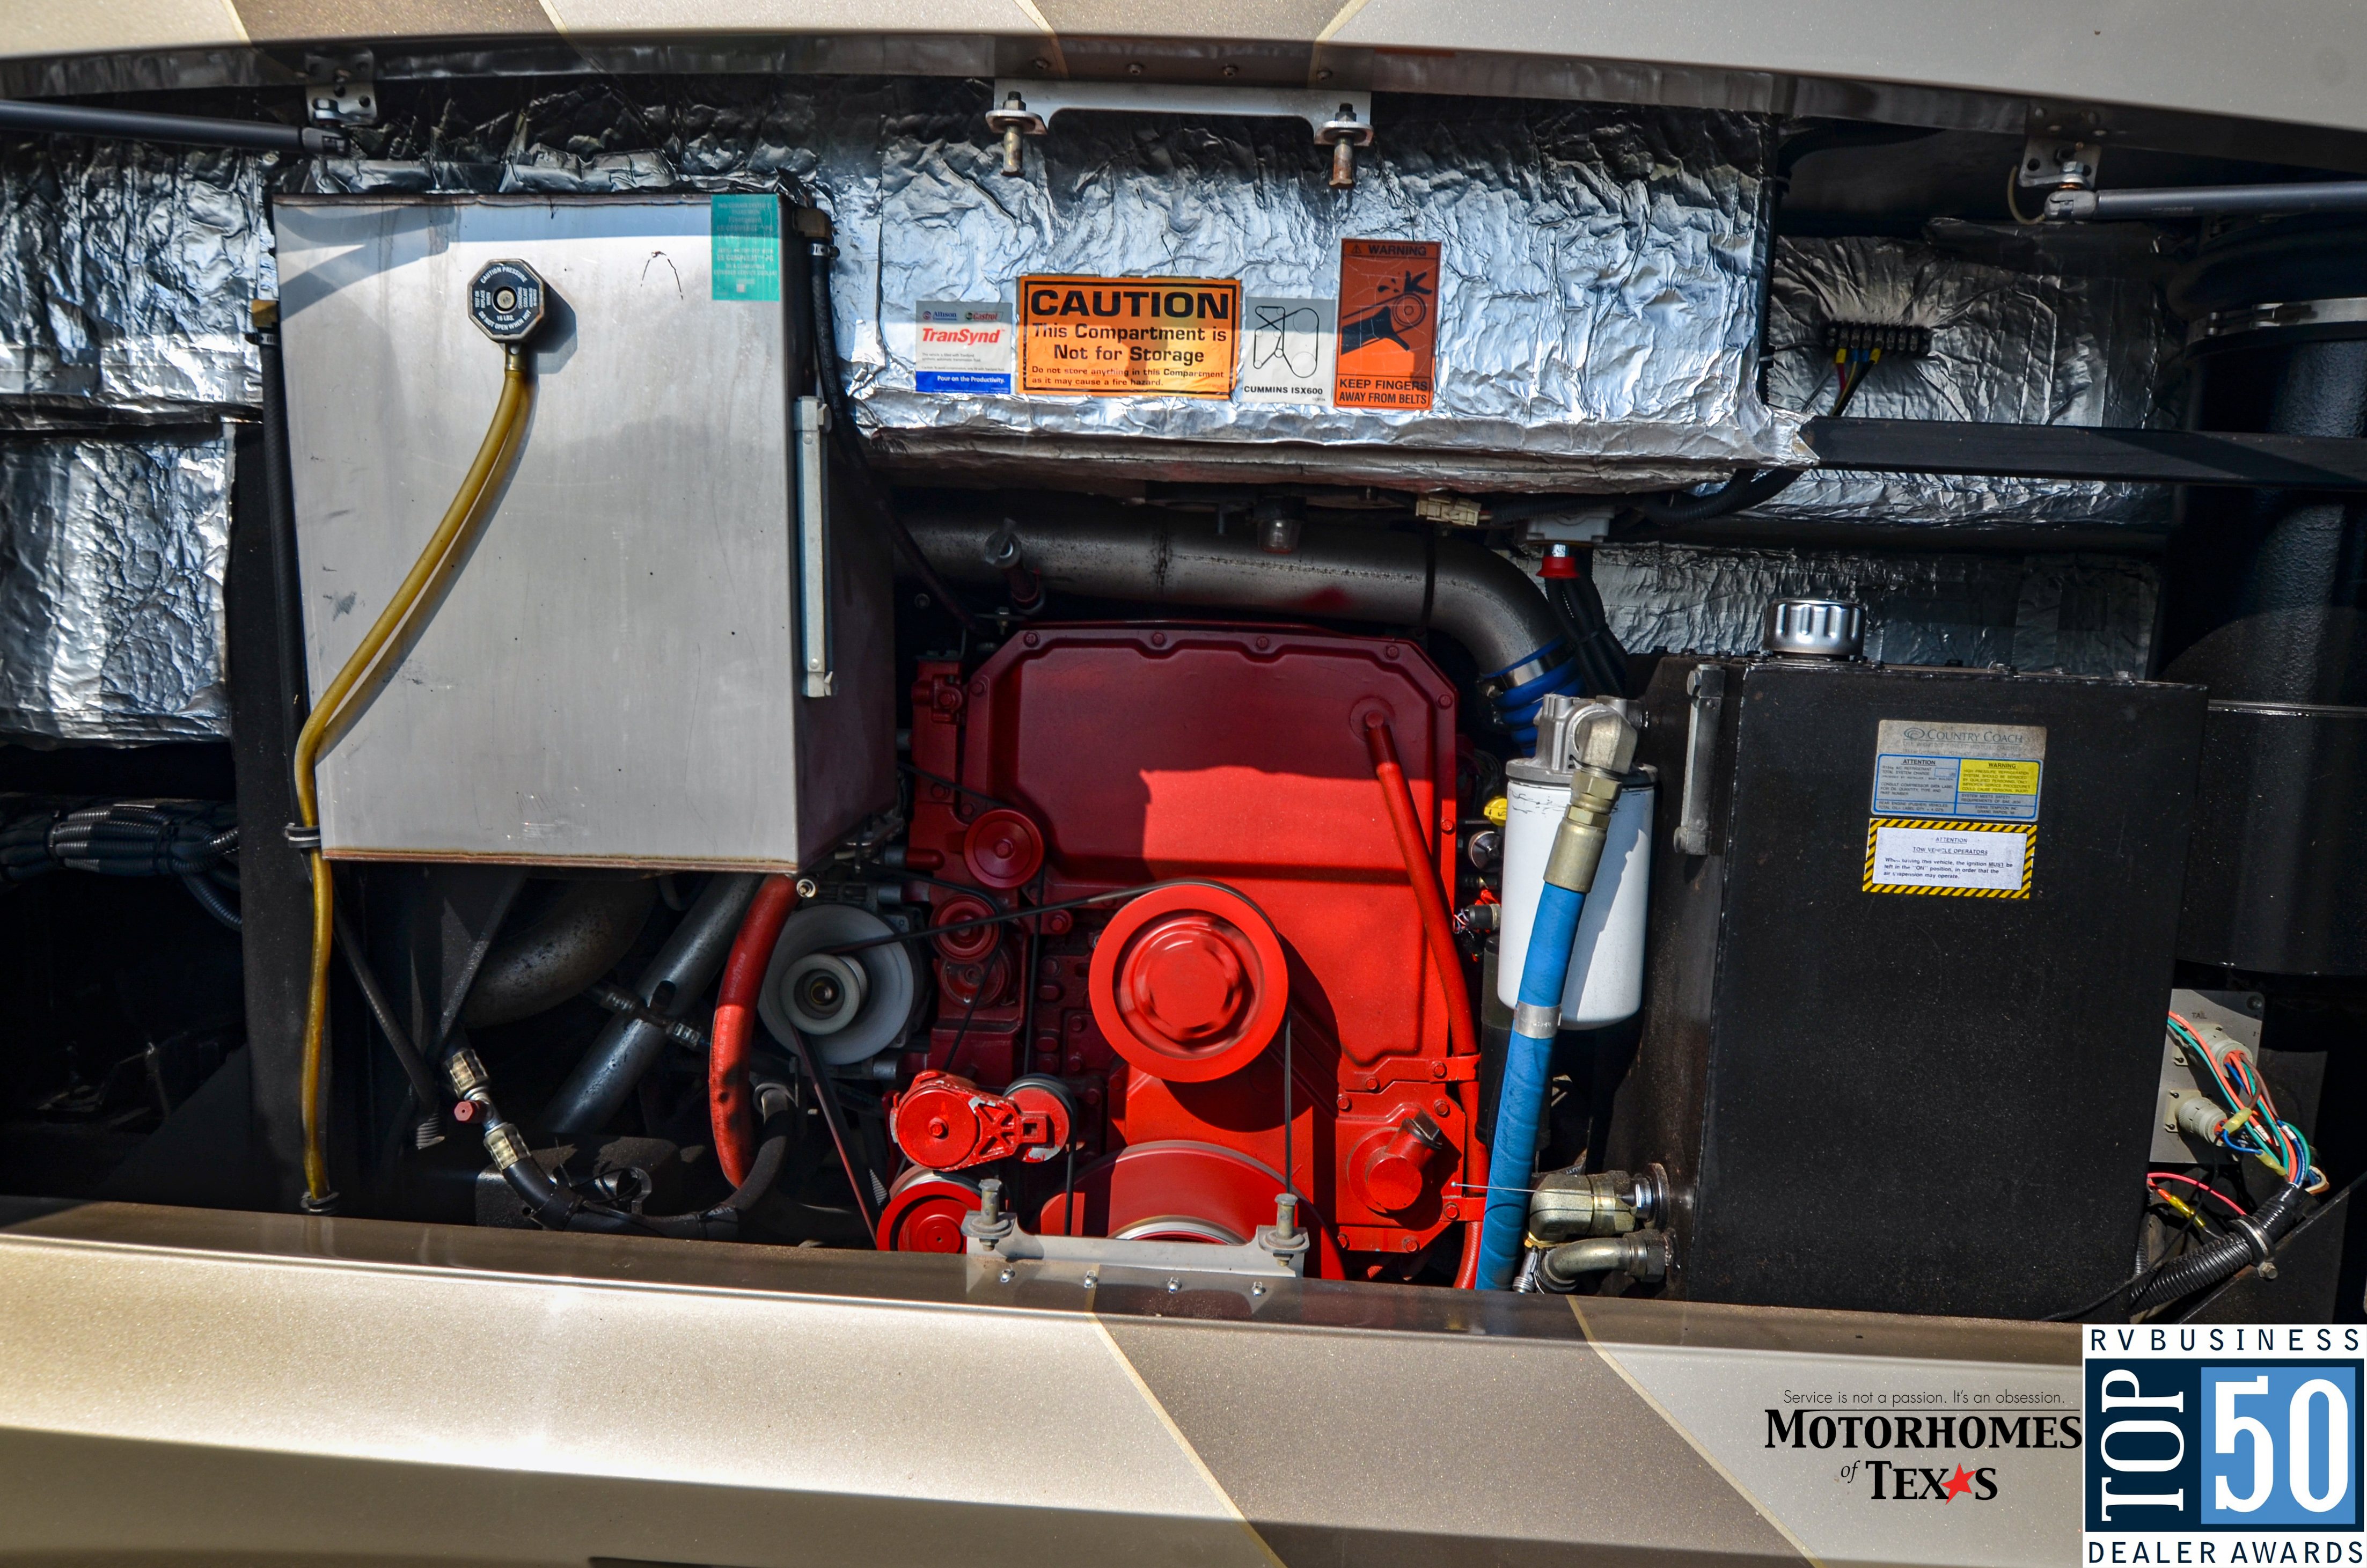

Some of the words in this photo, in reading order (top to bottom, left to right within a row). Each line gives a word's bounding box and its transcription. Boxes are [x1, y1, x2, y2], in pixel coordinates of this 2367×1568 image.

[1368, 245, 1426, 257] WARNING
[480, 267, 501, 284] CAUTION
[502, 266, 528, 283] PRESSURE
[1031, 290, 1229, 319] CAUTION
[484, 317, 495, 327] NOT
[509, 319, 524, 329] WHEN
[522, 309, 531, 320] HOT
[1032, 323, 1067, 338] This
[1075, 323, 1205, 343] Compartment
[1212, 326, 1227, 341] is
[1054, 345, 1088, 359] Not
[1096, 346, 1122, 360] for
[1130, 346, 1204, 366] Storage
[1091, 368, 1129, 377] anything
[1163, 368, 1224, 378] Compartment
[971, 376, 1005, 384] Productivity.
[1340, 379, 1371, 389] KEEP
[1375, 380, 1427, 391] FINGERS
[1339, 392, 1366, 402] AWAY
[1368, 393, 1396, 403] FROM
[1399, 394, 1426, 405] BELTS
[1928, 729, 1980, 741] COUNTRY
[1984, 731, 2023, 743] COACH
[722, 1023, 728, 1031] IN
